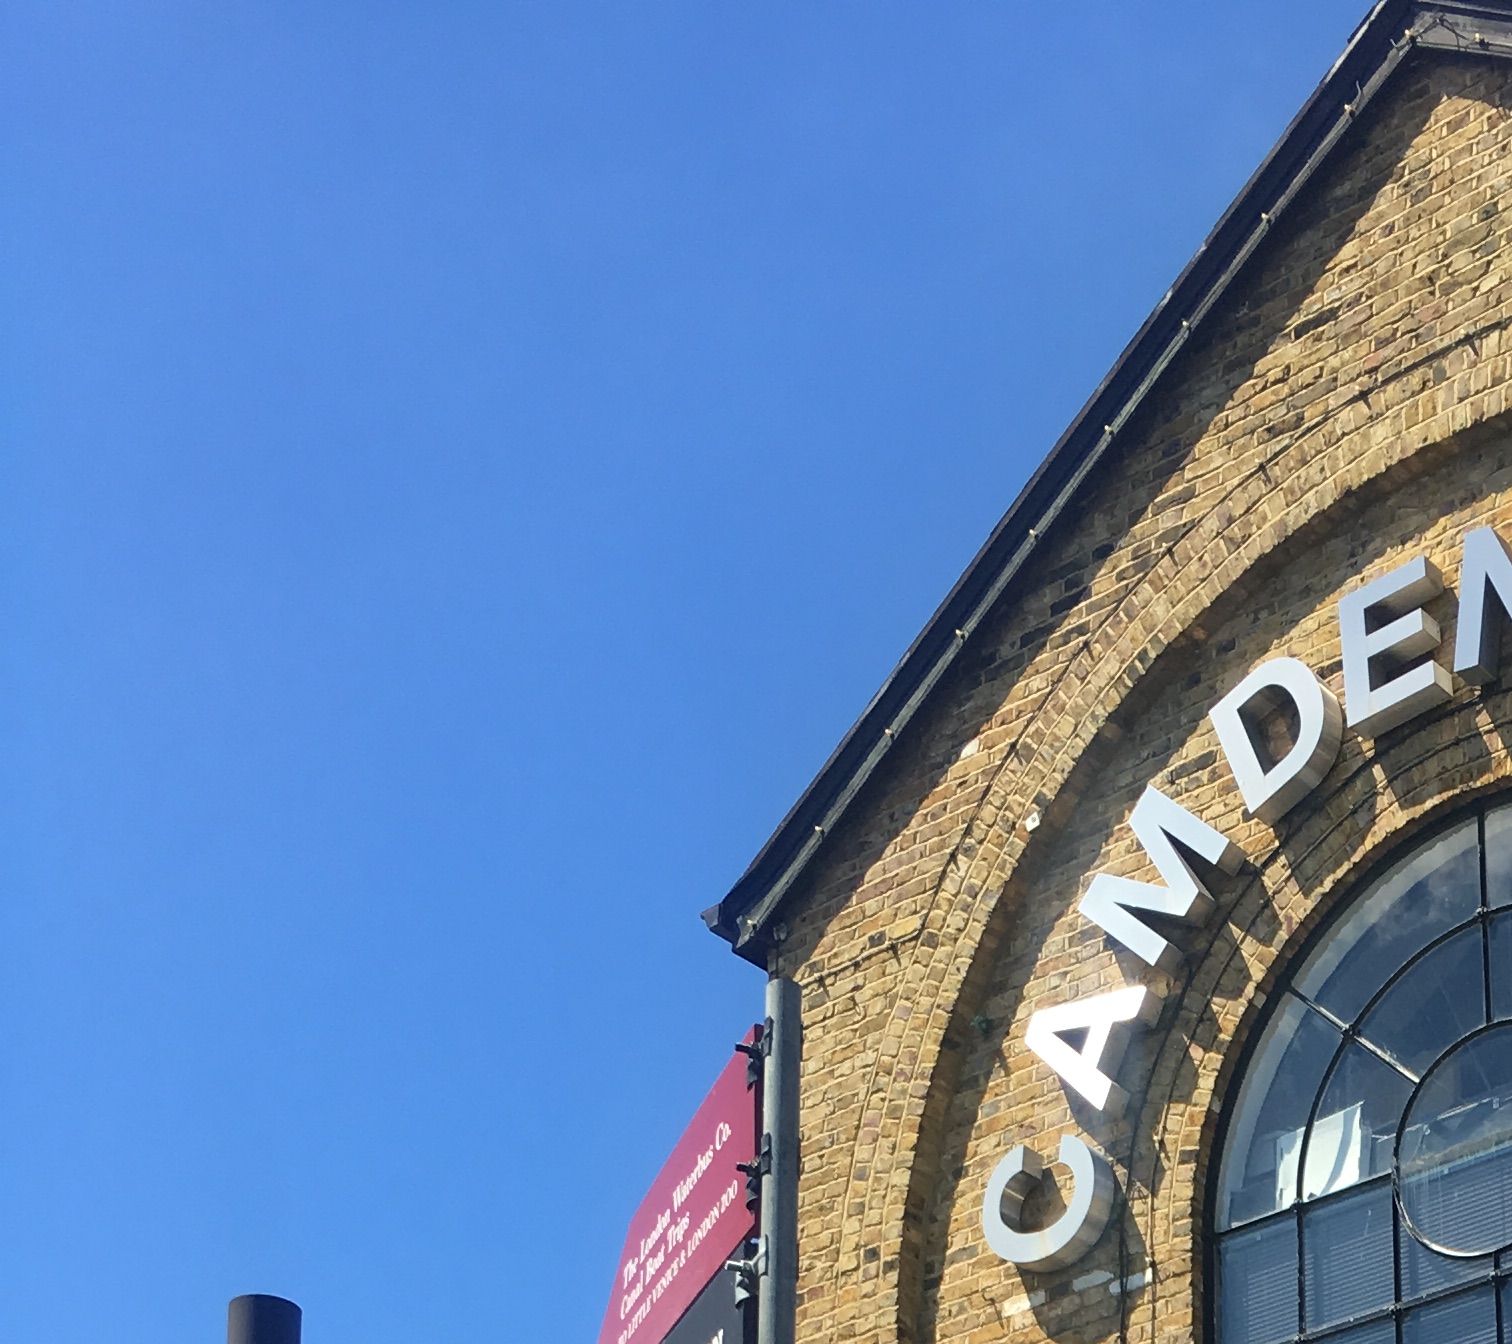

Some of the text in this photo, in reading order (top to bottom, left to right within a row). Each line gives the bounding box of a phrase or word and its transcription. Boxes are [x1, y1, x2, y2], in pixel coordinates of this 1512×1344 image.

[619, 1211, 690, 1321] Canal Boat Trips
[623, 1121, 732, 1290] The London Waterbus Co.
[627, 1295, 652, 1339] LITTLE
[652, 1257, 680, 1304] VENICE
[687, 1201, 721, 1259] LONDON
[720, 1179, 739, 1213] ZOO
